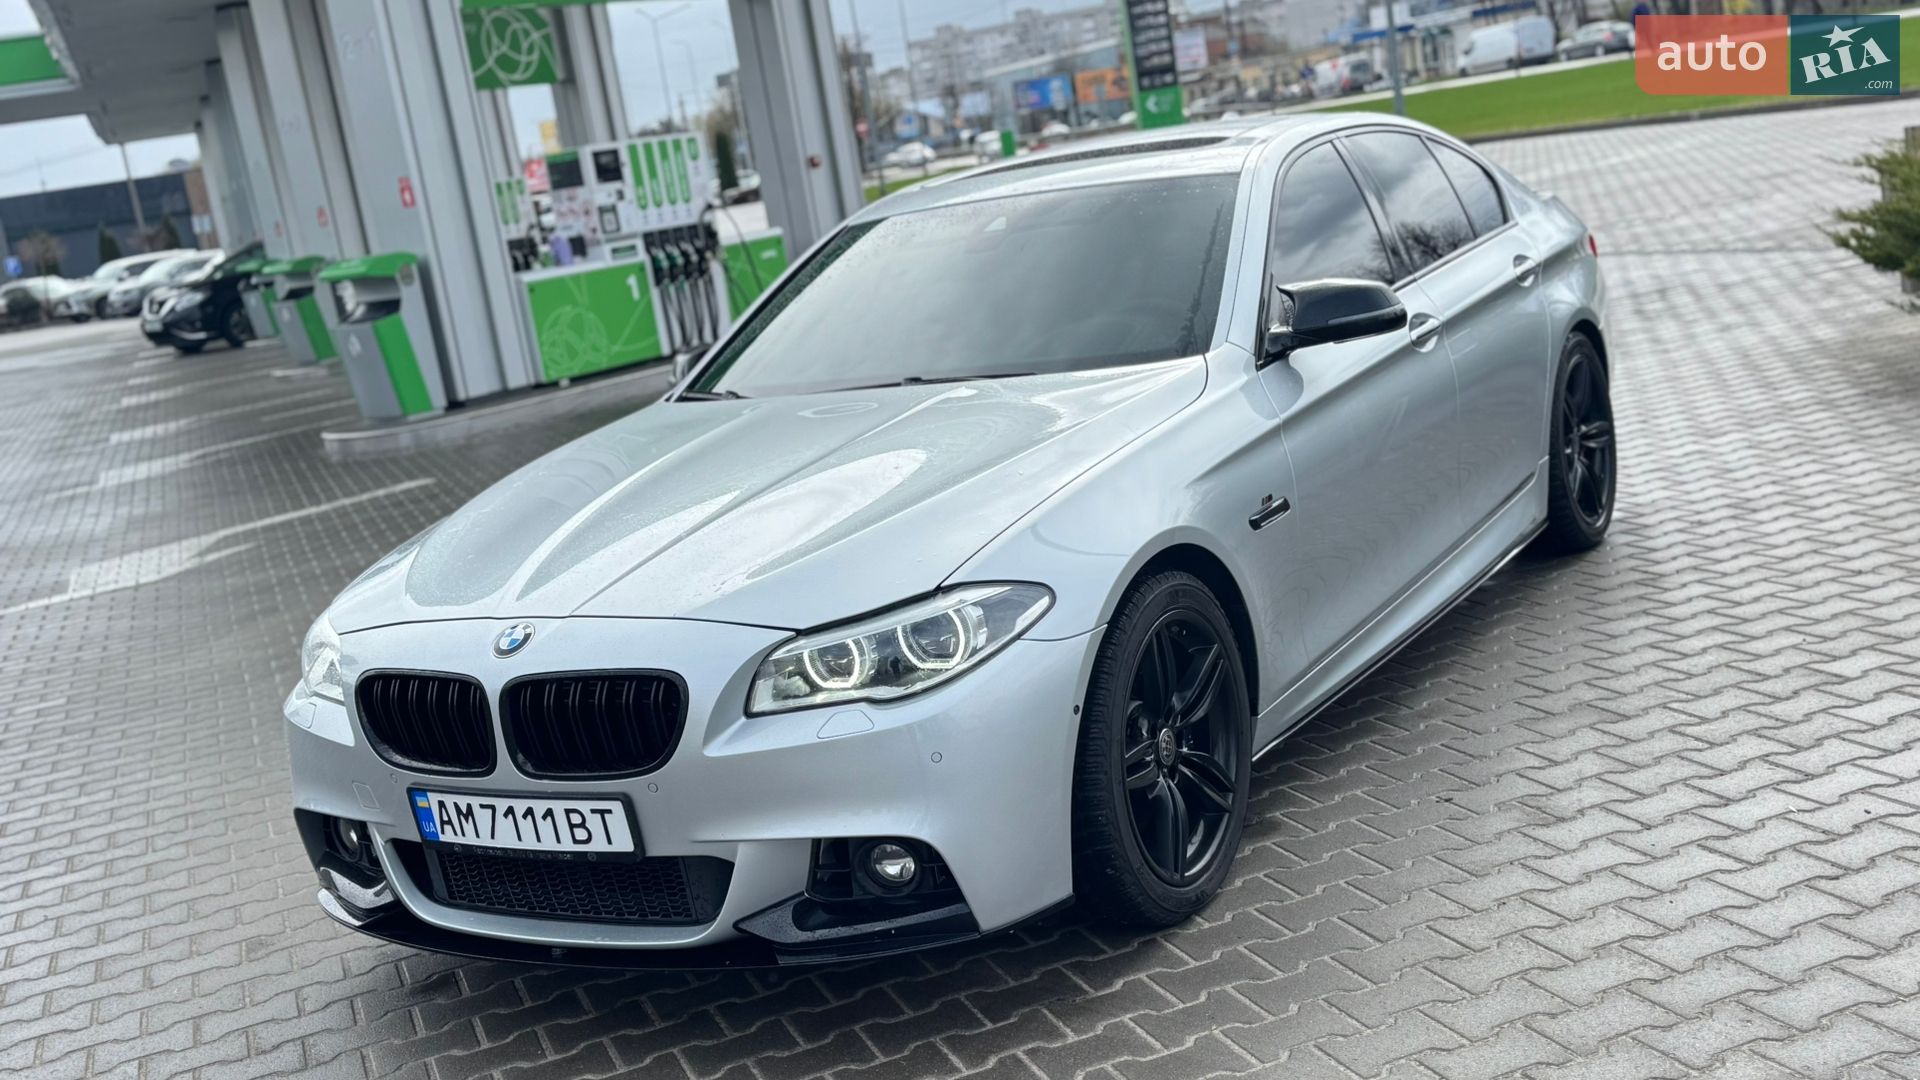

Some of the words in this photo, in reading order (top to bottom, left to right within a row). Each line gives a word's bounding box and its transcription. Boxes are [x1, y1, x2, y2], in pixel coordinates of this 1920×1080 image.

[626, 274, 640, 301] 1
[422, 820, 437, 833] UA
[437, 799, 613, 846] AM7111BT
